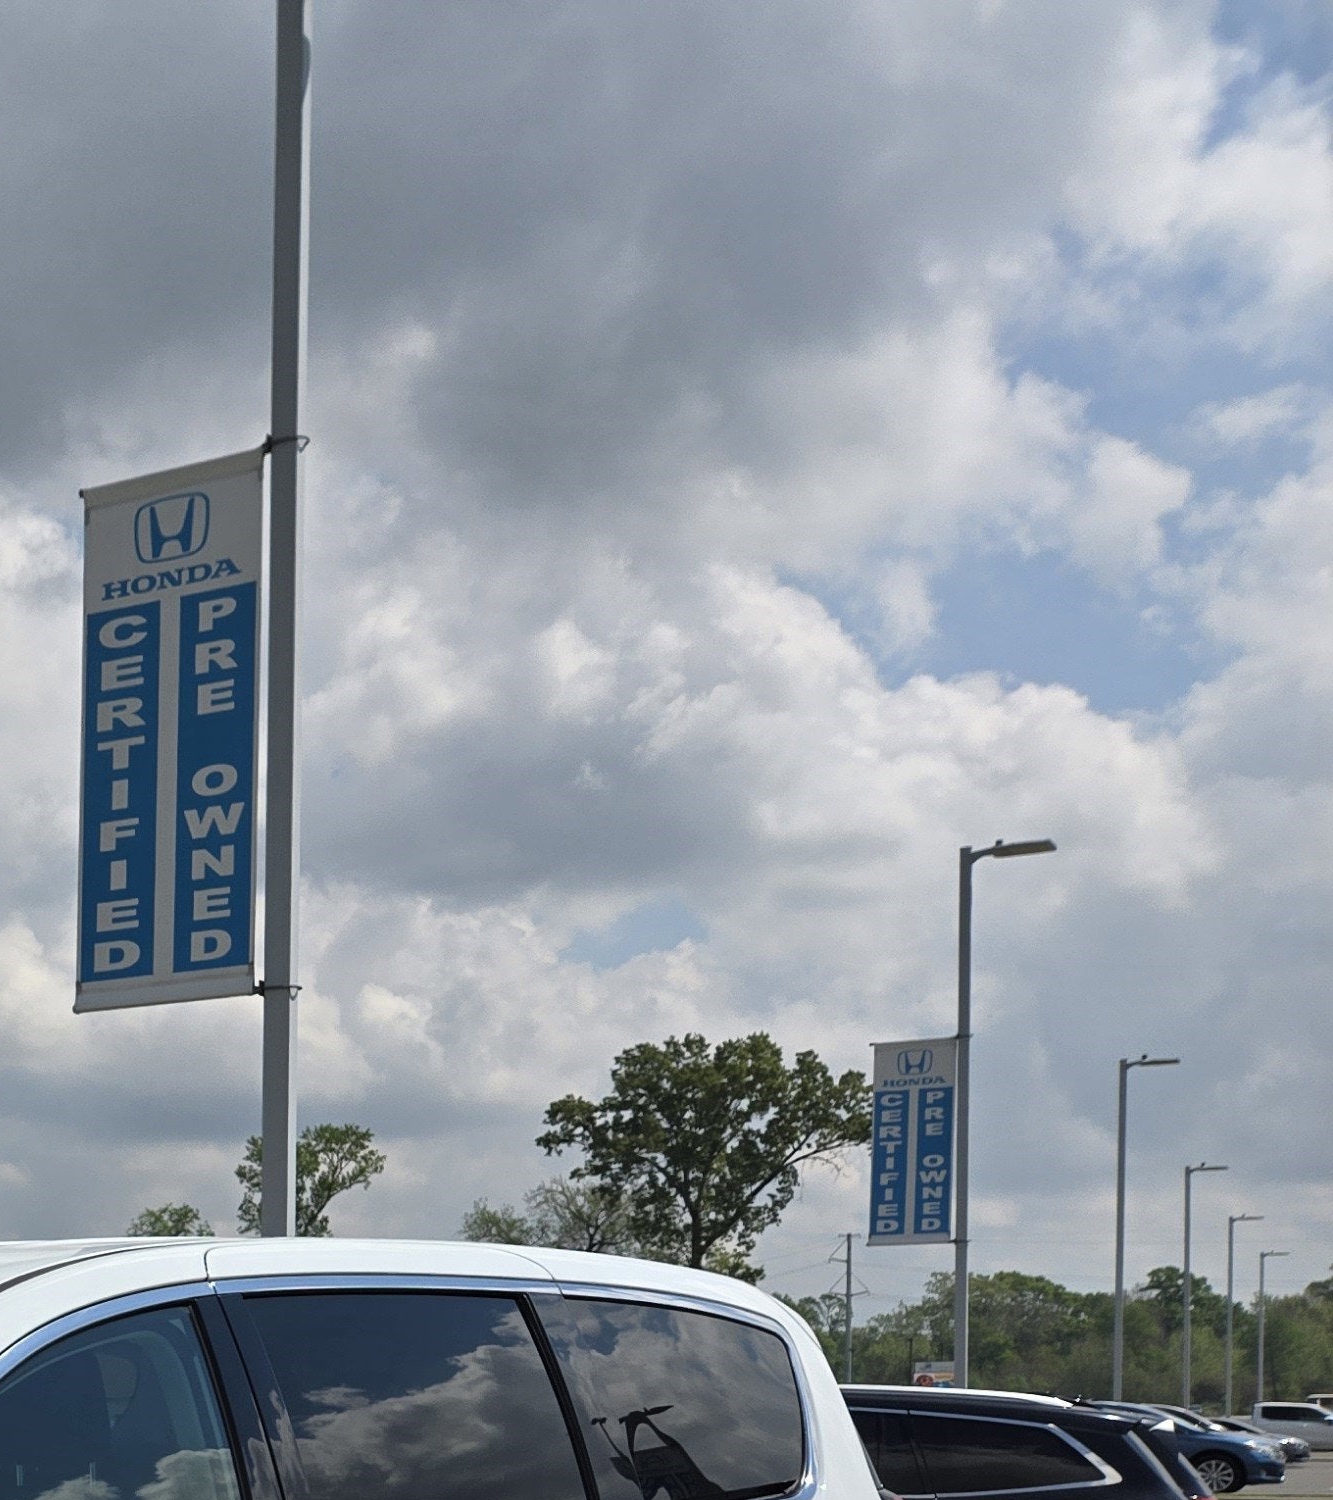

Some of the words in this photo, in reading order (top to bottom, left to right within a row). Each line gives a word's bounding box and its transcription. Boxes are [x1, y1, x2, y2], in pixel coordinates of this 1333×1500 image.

[101, 558, 242, 600] HONDA
[194, 597, 237, 717] PRE
[93, 613, 148, 974] CERTIFIED
[183, 762, 245, 963] OWNED
[882, 1075, 948, 1088] HONDA
[924, 1090, 946, 1136] PRE
[875, 1093, 904, 1233] CERTIFIED
[919, 1154, 947, 1231] OWNED
